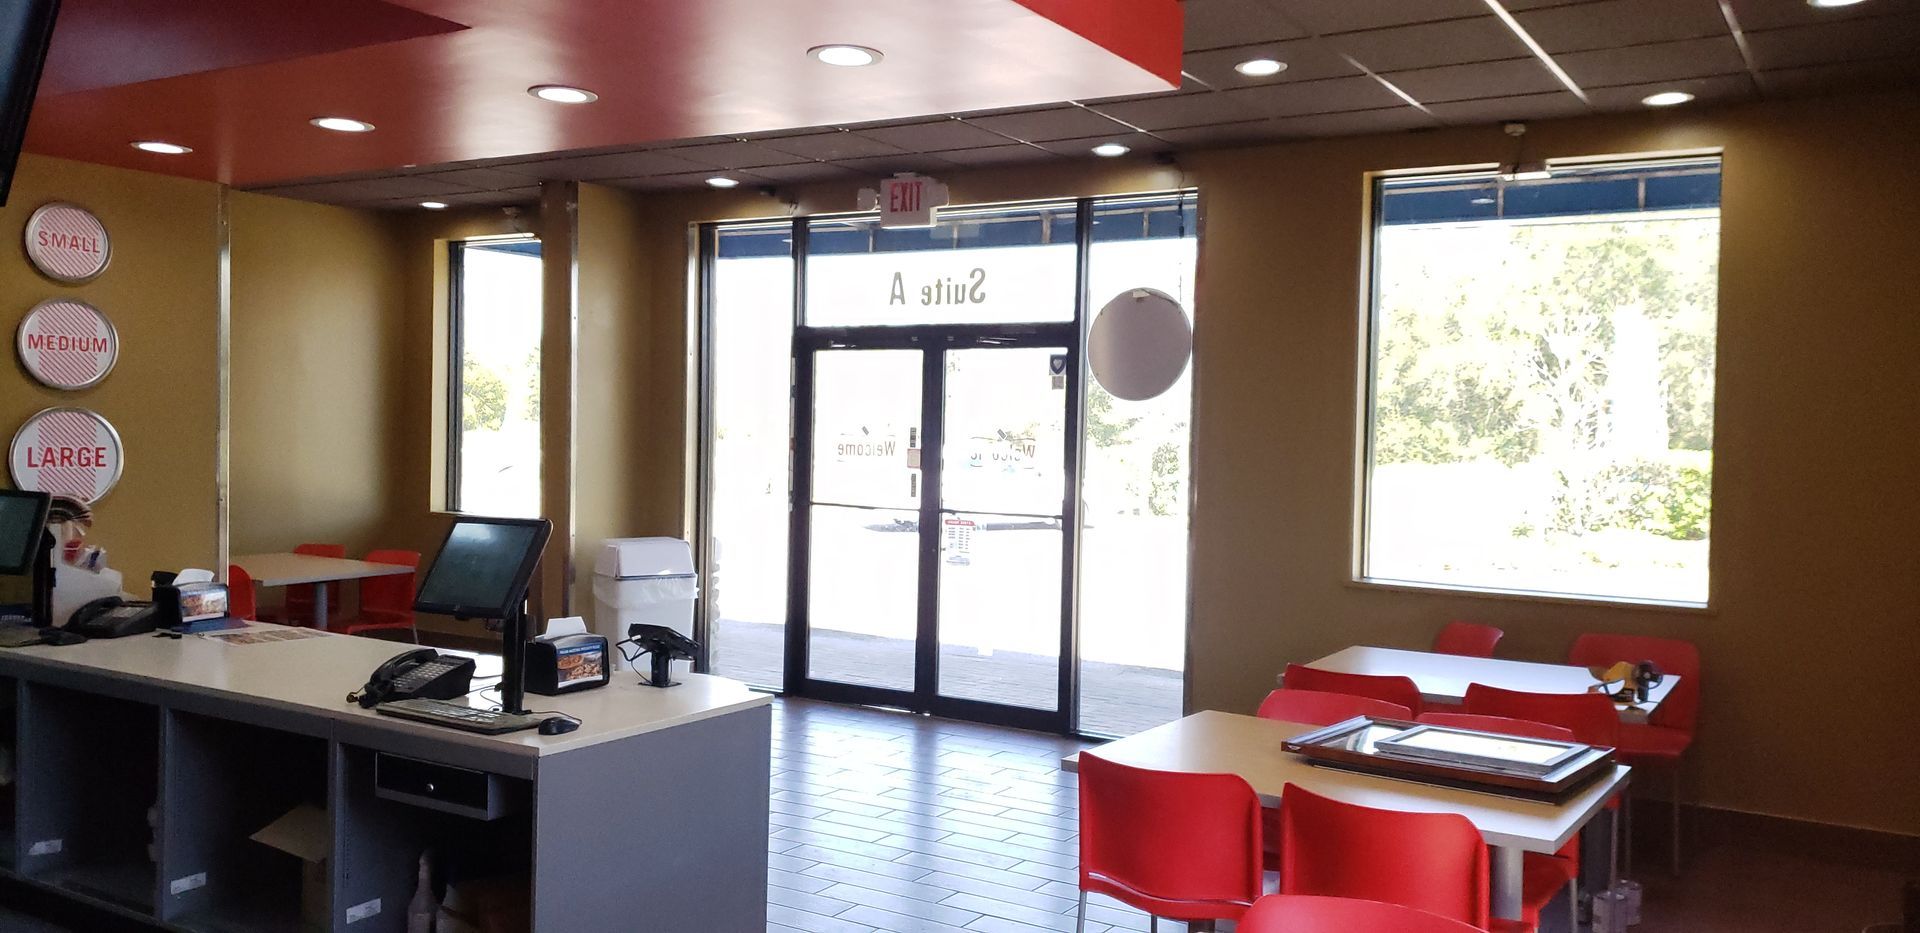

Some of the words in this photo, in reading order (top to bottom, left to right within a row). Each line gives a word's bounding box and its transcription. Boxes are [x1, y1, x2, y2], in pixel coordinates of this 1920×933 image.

[890, 182, 922, 212] EXIT
[38, 231, 101, 253] SMALL
[27, 333, 108, 353] MEDIUM
[27, 446, 107, 468] LARGE
